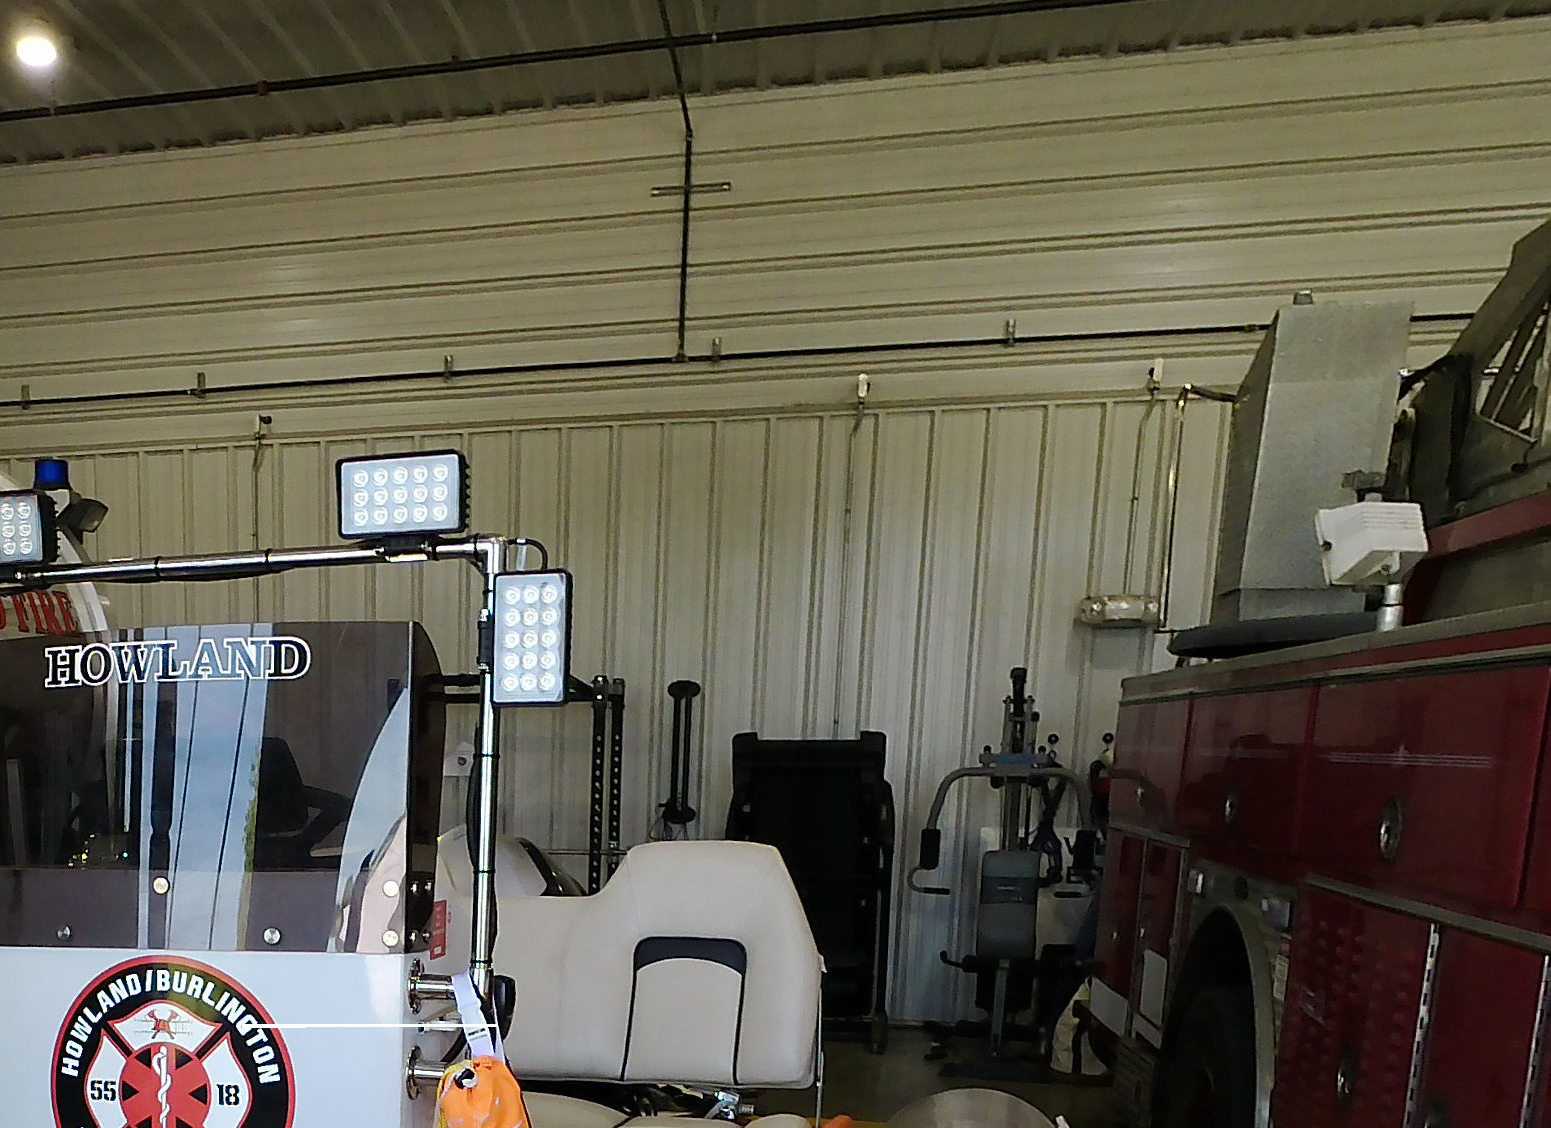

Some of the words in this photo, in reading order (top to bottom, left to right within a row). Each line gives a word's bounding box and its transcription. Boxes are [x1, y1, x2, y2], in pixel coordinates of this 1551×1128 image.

[10, 590, 83, 637] FIRE
[45, 637, 311, 688] HOWLAND
[90, 1079, 117, 1101] 55
[216, 1084, 240, 1106] 18
